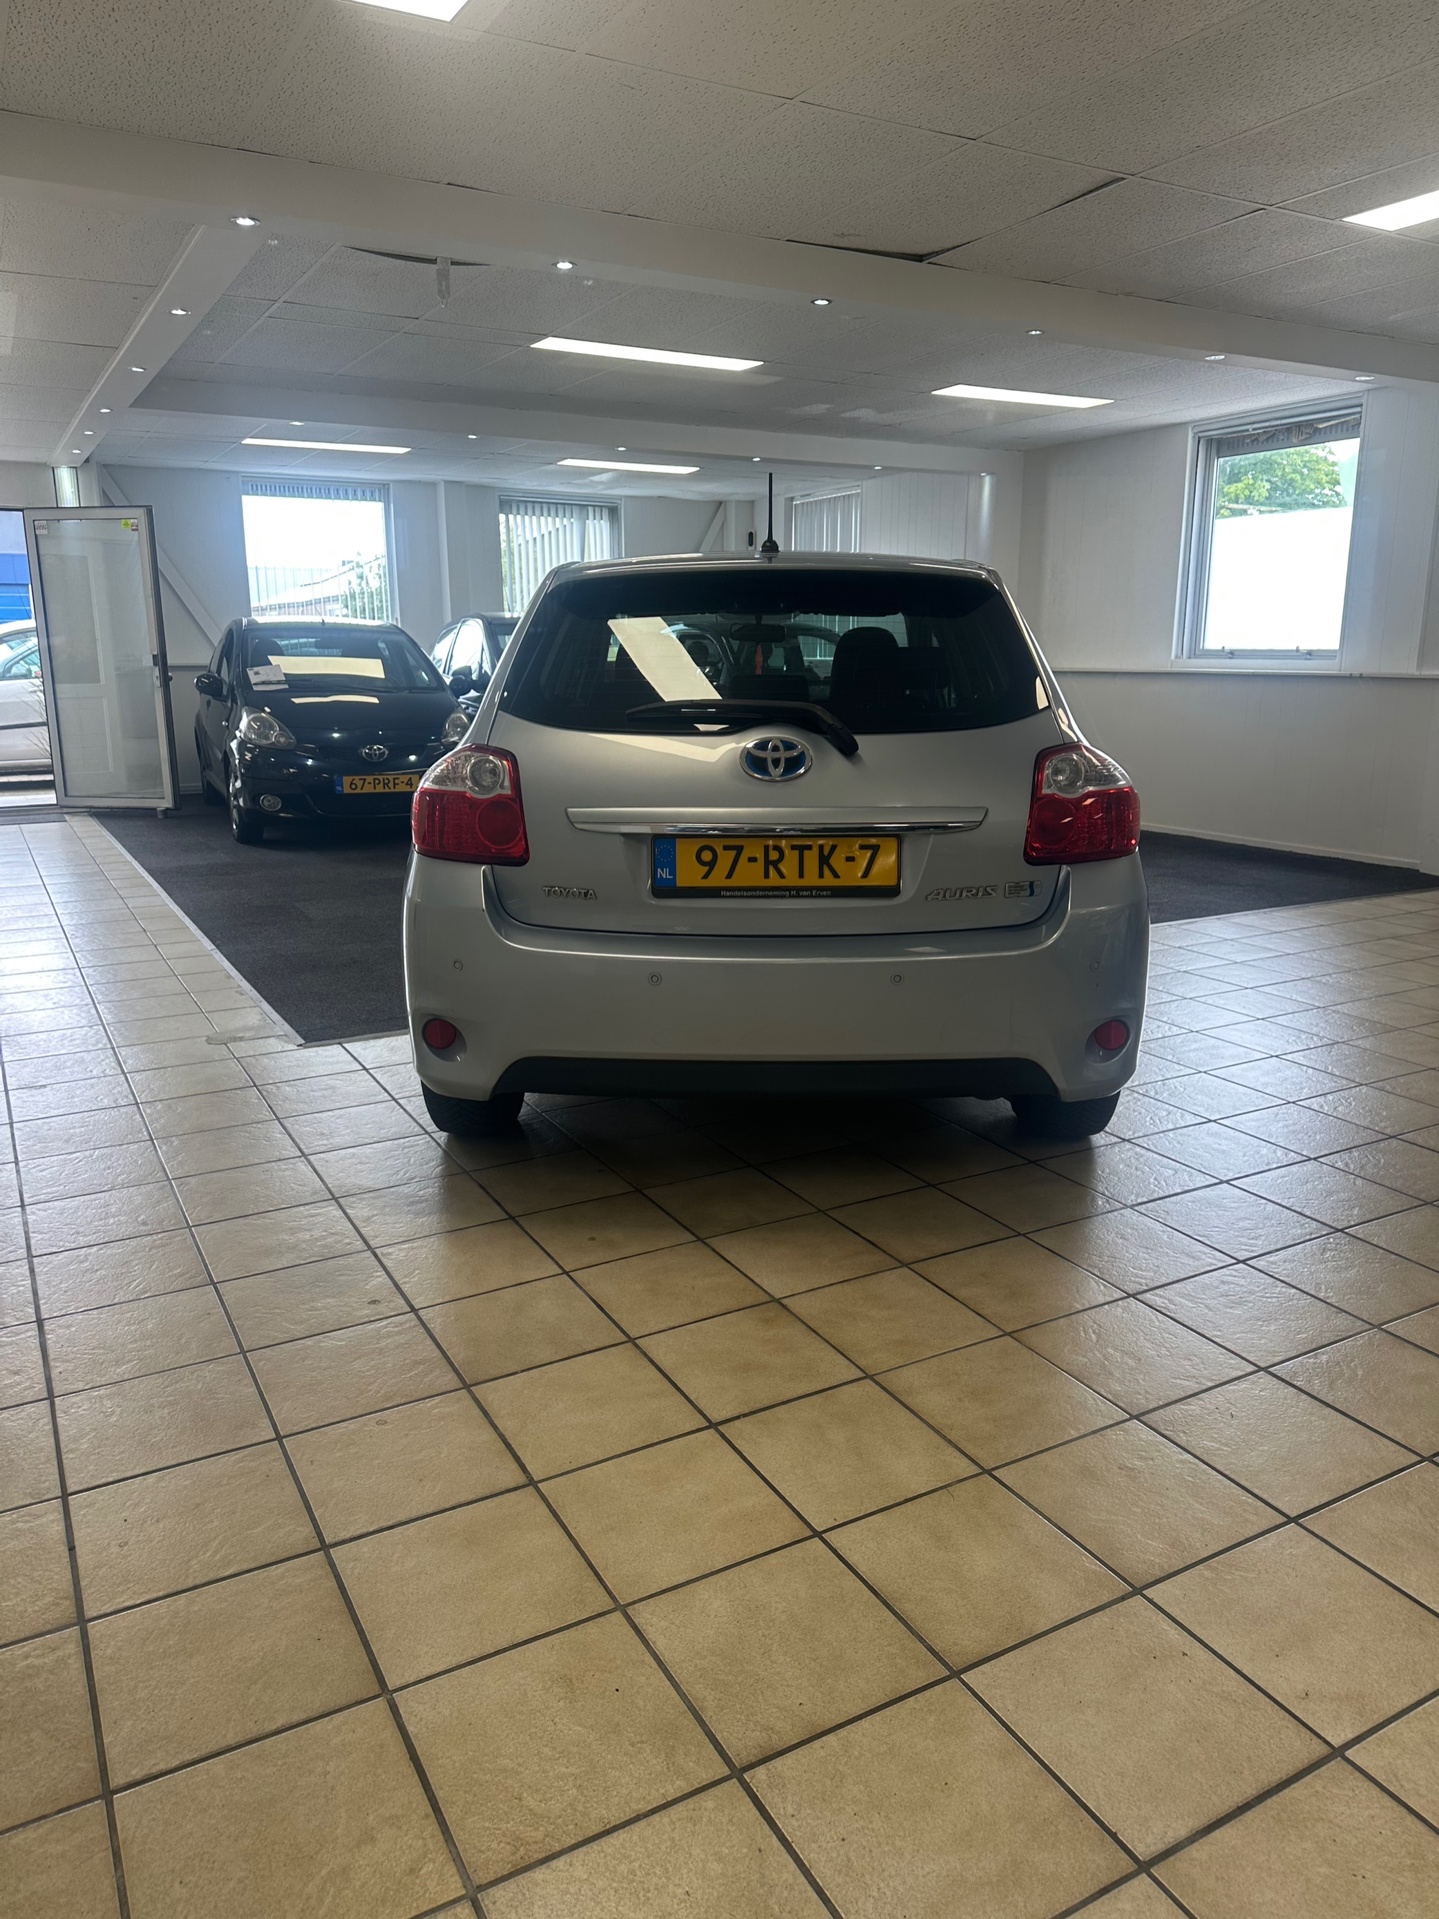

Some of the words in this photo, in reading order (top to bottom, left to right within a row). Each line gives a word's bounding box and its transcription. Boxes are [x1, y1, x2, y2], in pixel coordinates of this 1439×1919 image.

[349, 777, 414, 791] 67-PRF-4
[695, 844, 881, 880] 97-RTK-7
[657, 868, 673, 879] NL
[542, 886, 598, 900] TOYOTA
[720, 889, 789, 897] Handelsonderneming
[926, 885, 998, 901] AURIS
